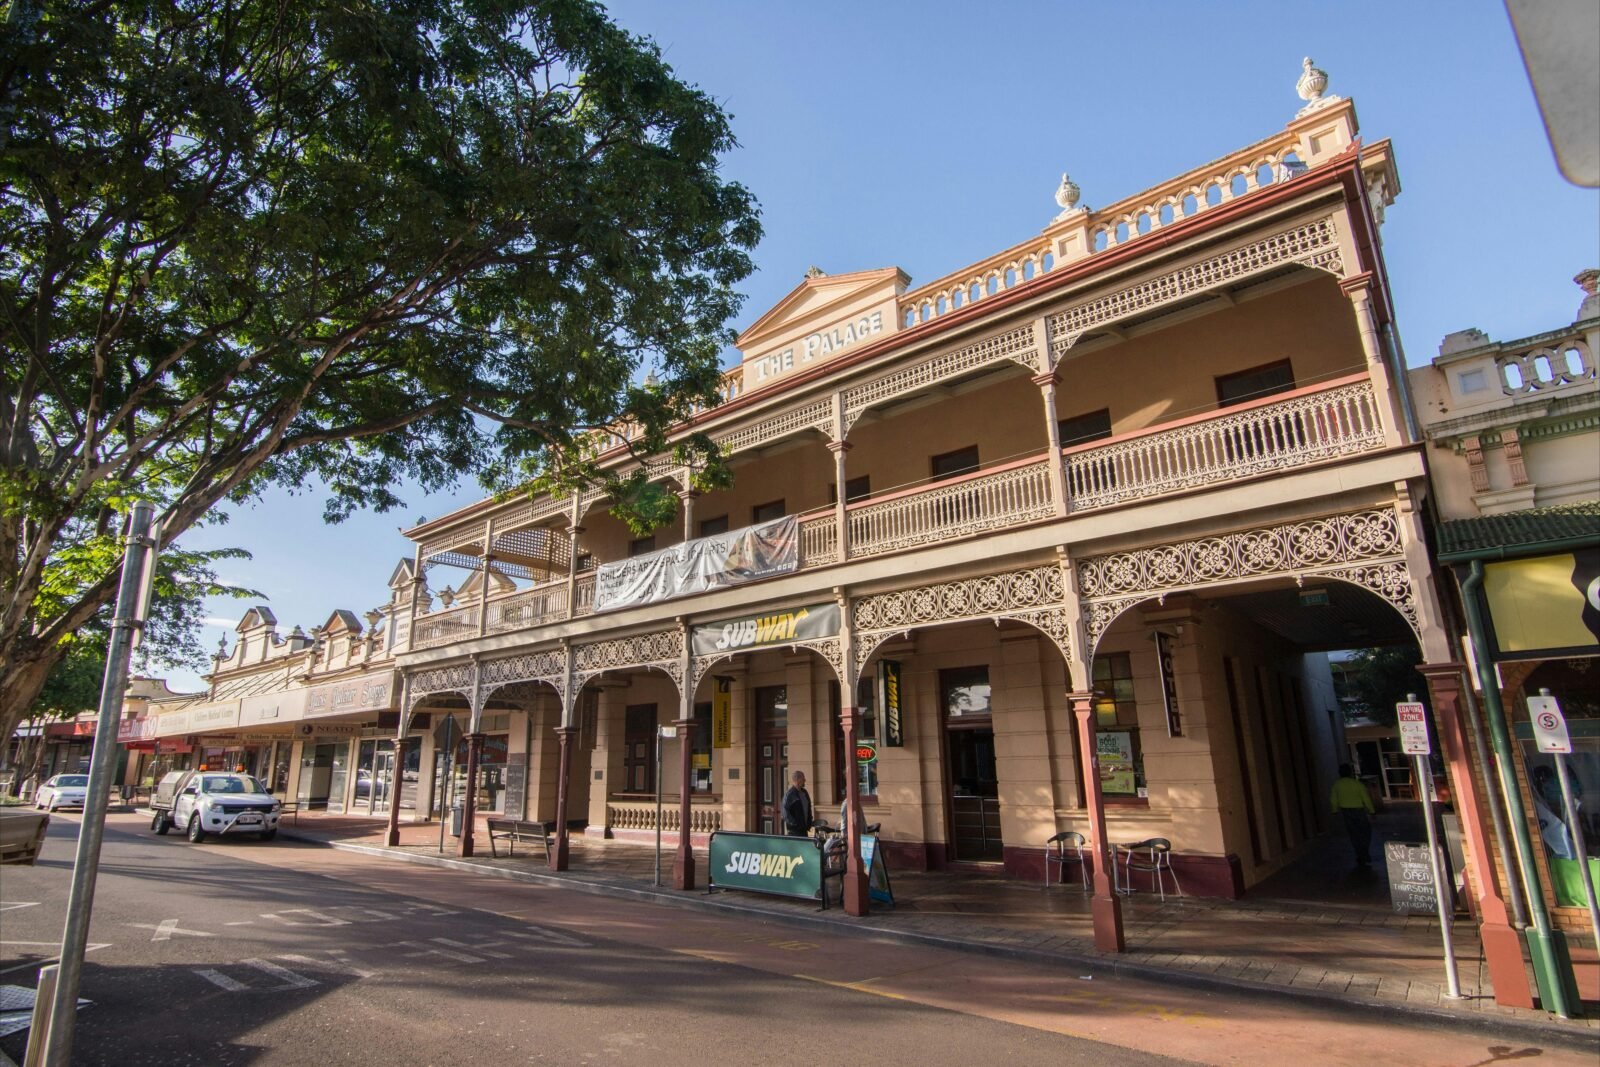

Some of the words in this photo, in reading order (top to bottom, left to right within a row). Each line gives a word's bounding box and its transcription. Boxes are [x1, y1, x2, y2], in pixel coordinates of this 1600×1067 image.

[754, 348, 794, 381] THE
[801, 310, 883, 362] PALACE
[715, 608, 809, 650] SUBWAY
[886, 664, 900, 745] SUBWAY
[1403, 713, 1420, 721] ZONE
[856, 748, 873, 759] PEN
[725, 851, 804, 878] SUBWAY
[1393, 883, 1434, 895] THURSDAY
